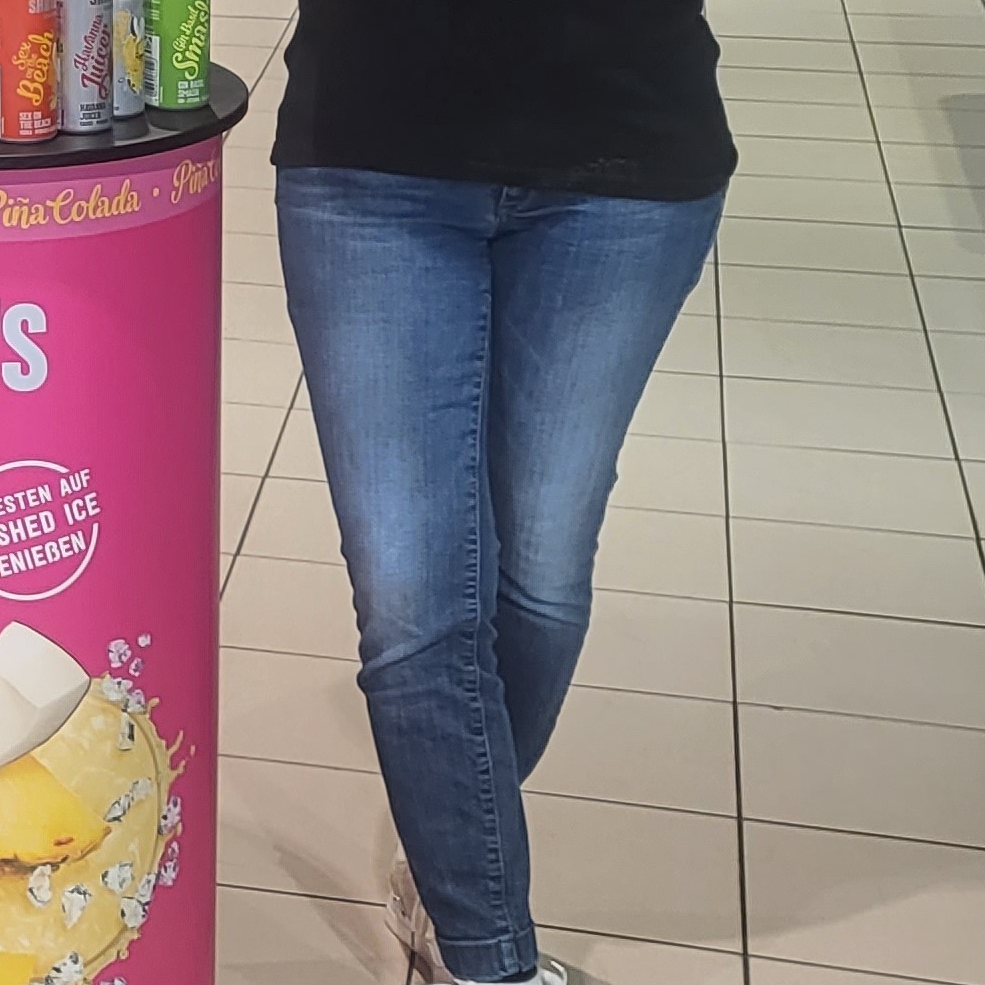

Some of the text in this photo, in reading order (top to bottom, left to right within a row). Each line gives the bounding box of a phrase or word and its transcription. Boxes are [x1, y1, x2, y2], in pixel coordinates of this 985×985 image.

[12, 41, 31, 71] Sex
[16, 30, 54, 106] Beach
[19, 112, 32, 121] SEX
[19, 118, 52, 129] THE BEACH
[59, 468, 91, 495] AUF
[64, 491, 101, 525] ICE
